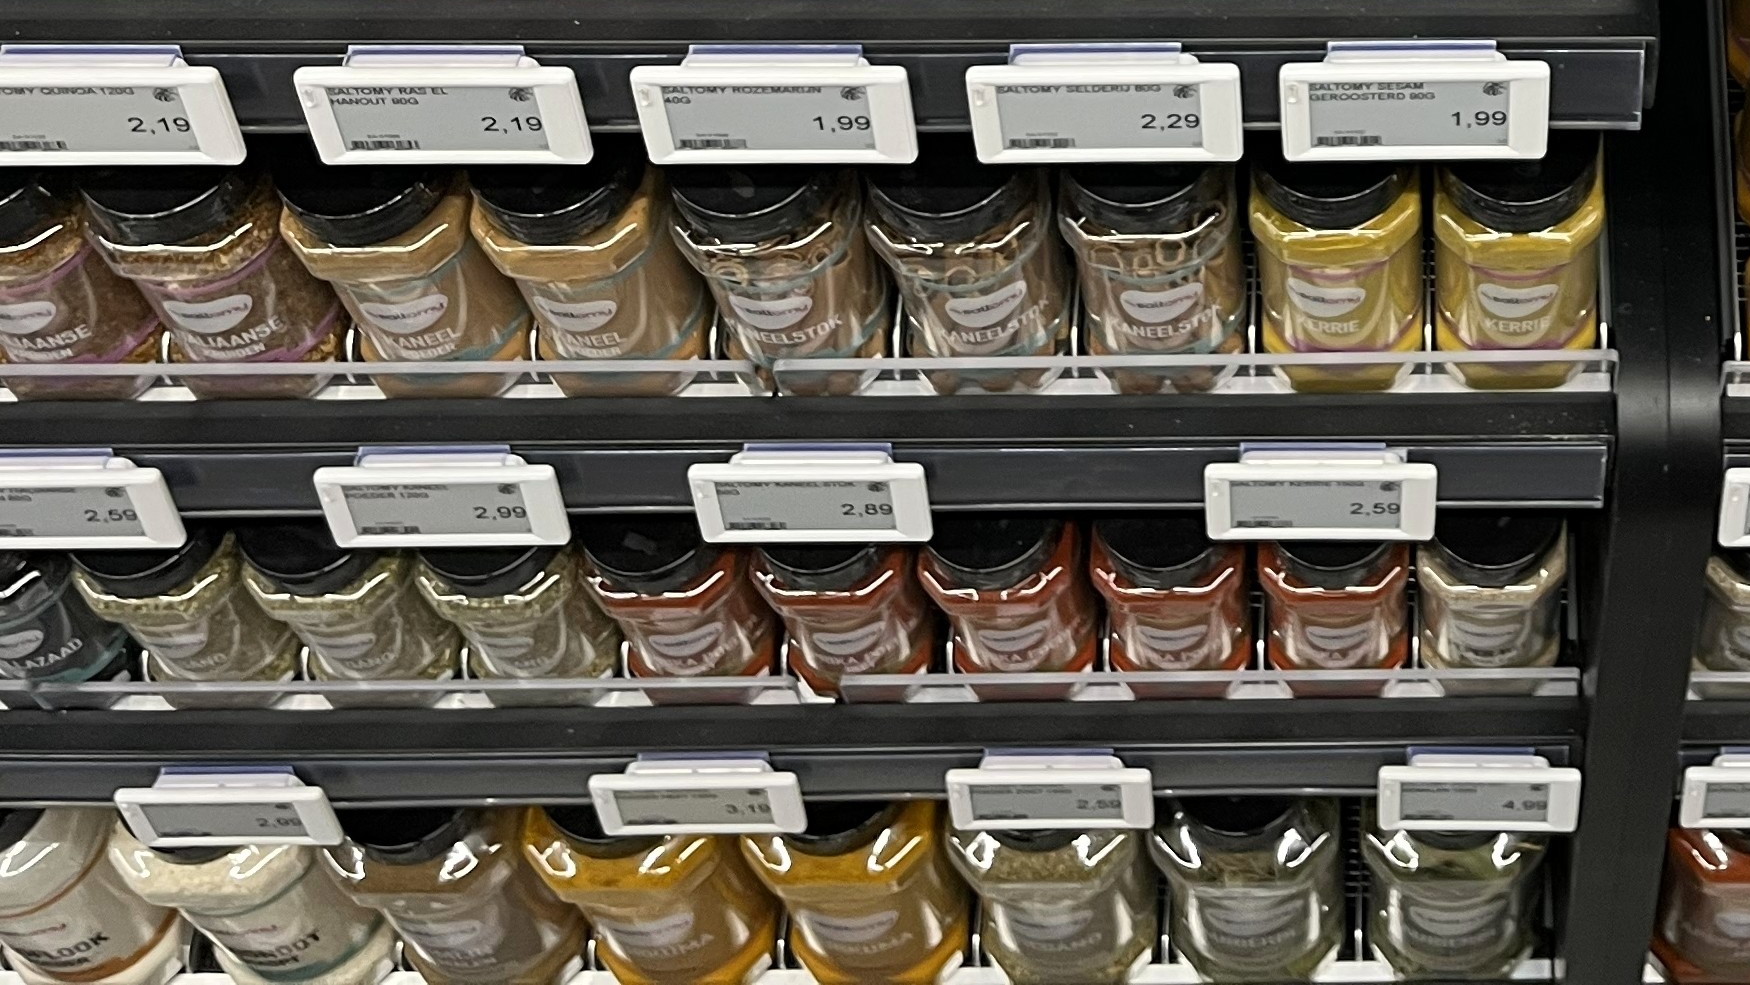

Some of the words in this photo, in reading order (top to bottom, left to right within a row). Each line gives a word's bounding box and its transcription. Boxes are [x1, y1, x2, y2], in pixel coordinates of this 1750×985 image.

[128, 117, 191, 134] 2,19
[481, 116, 542, 134] 2,19
[813, 116, 870, 133] 1,99
[1141, 113, 1199, 131] 2,29
[1451, 111, 1507, 128] 1,99
[84, 509, 138, 523] 2,59
[1350, 502, 1400, 516] 2,59
